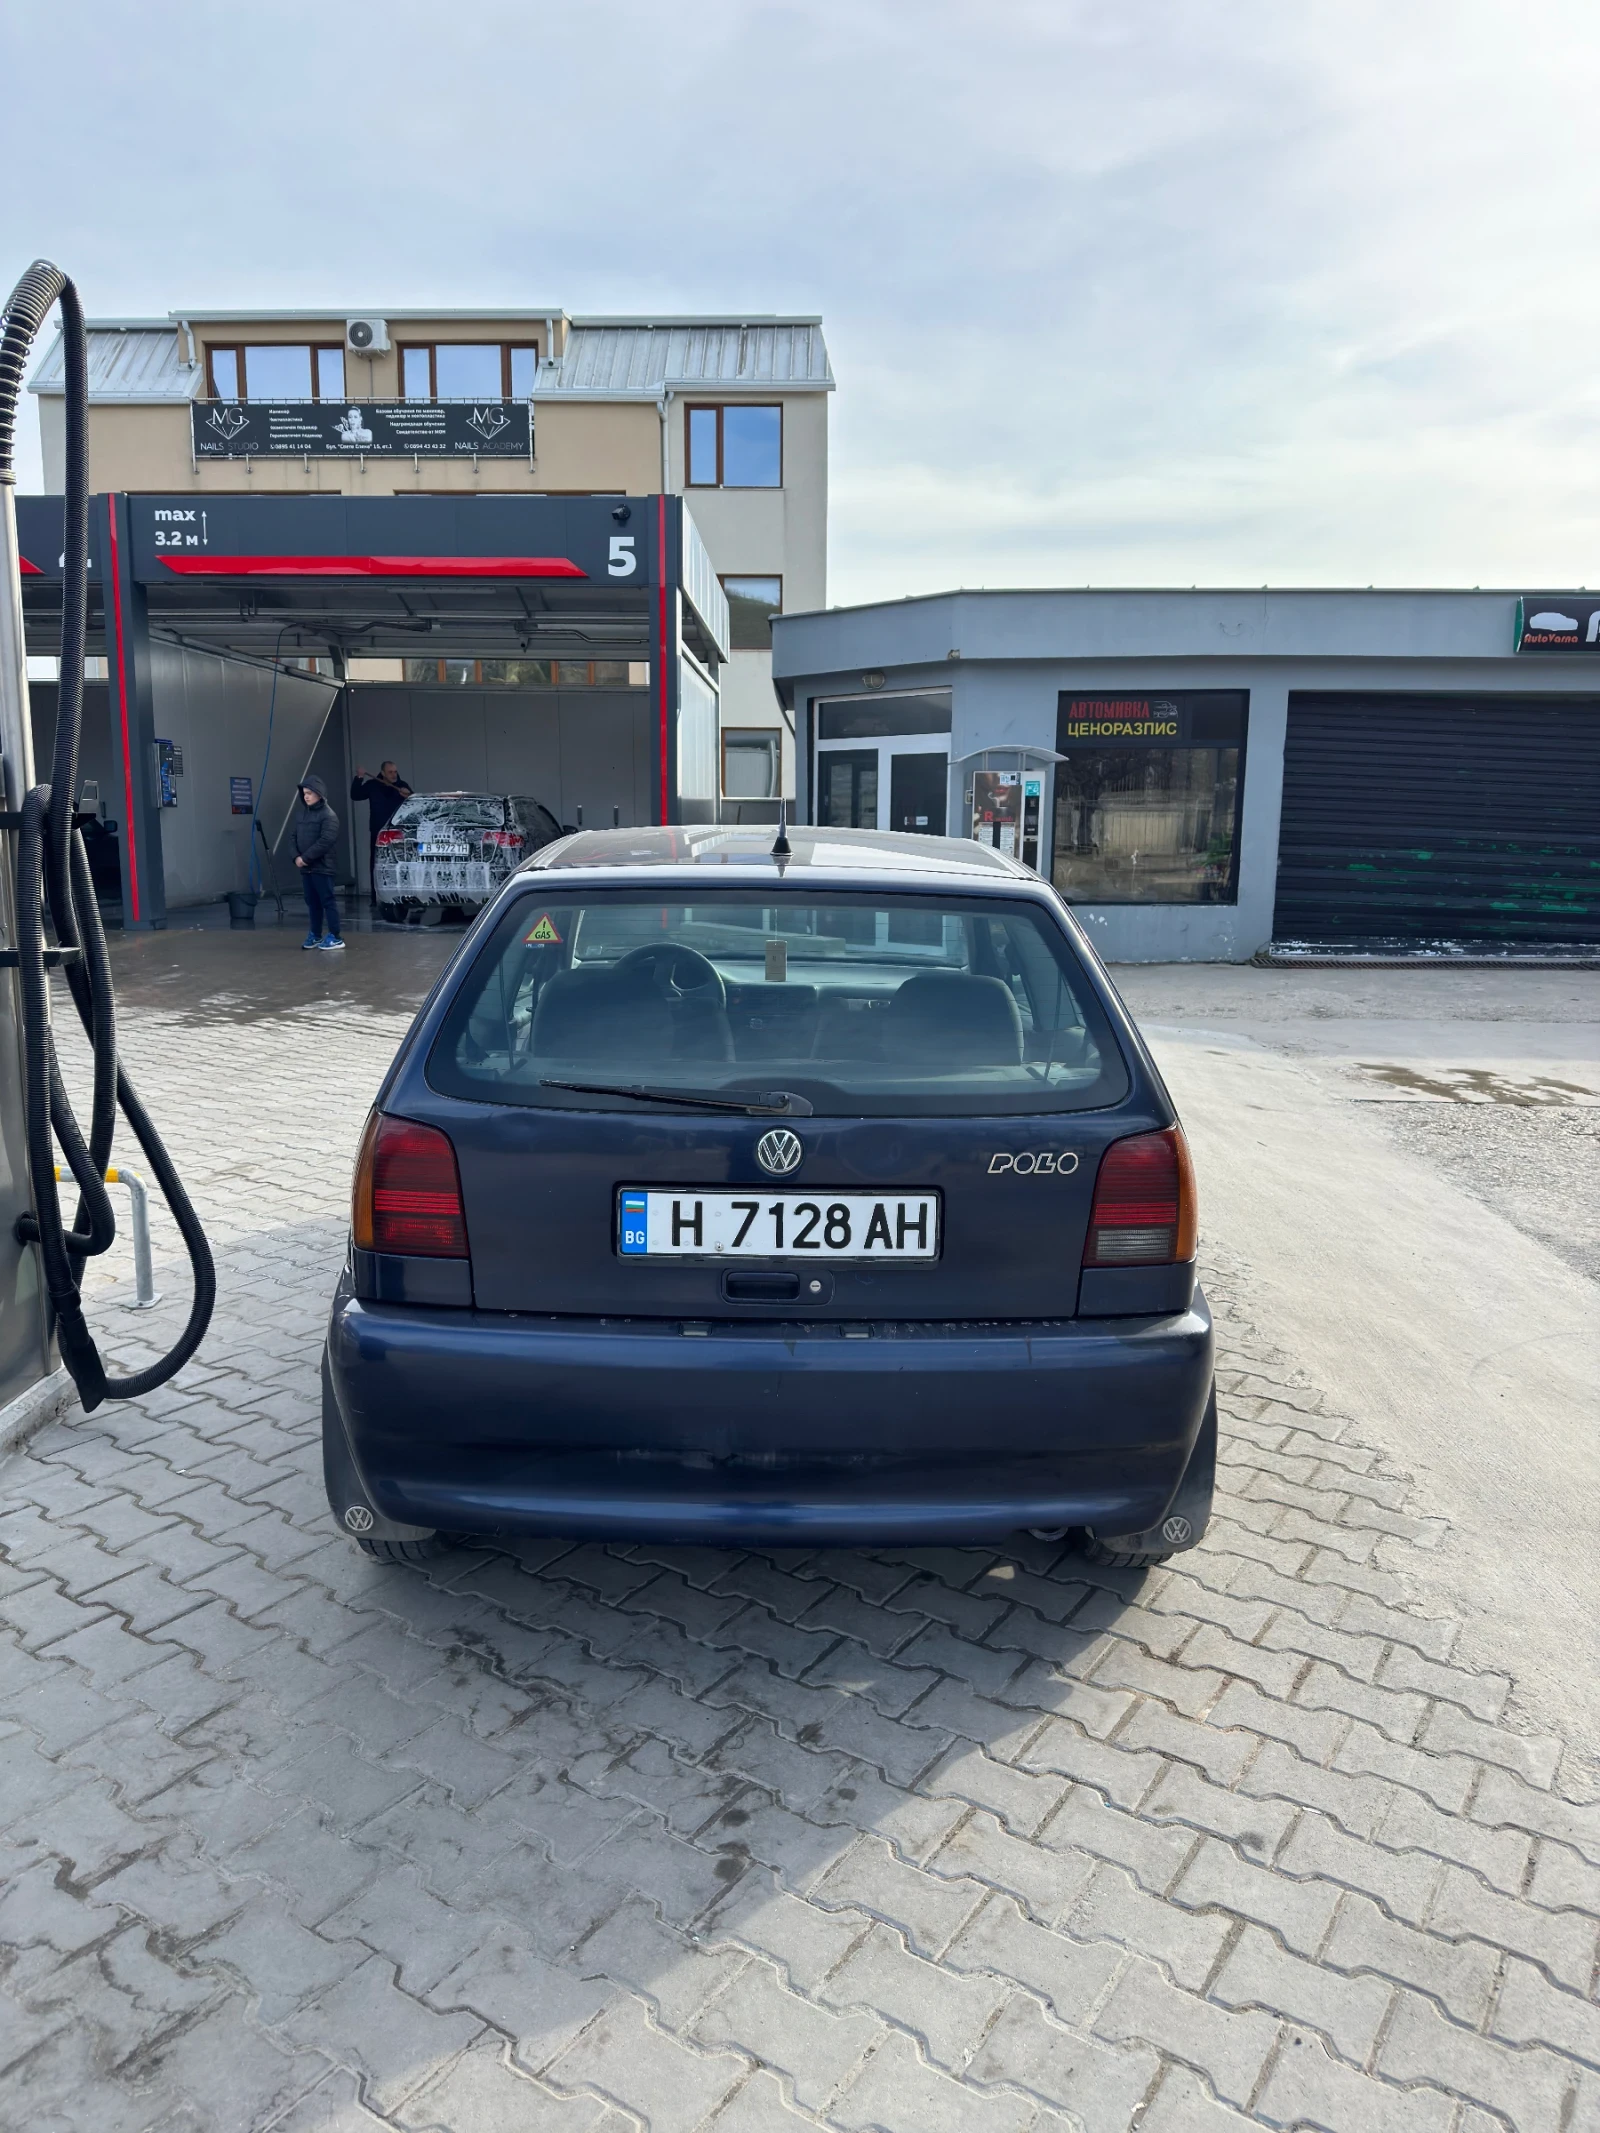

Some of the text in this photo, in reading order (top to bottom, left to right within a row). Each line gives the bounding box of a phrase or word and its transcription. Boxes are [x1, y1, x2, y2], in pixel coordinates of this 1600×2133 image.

[212, 407, 243, 425] MG
[472, 407, 504, 425] MG
[200, 442, 259, 450] NAILS STUDIO
[454, 442, 524, 451] NAILS ACADEMY
[154, 509, 196, 521] max
[155, 531, 182, 546] 3.2
[607, 536, 637, 577] 5
[1523, 633, 1579, 644] AutoVarna
[1069, 701, 1150, 719] АВТОМИВКА
[1067, 722, 1177, 738] ЦЕНОРАЗПИС
[435, 844, 456, 852] 9972
[534, 930, 551, 939] GAS
[987, 1152, 1079, 1175] POLO
[671, 1200, 928, 1250] H 7128 AH
[625, 1230, 645, 1245] BG
